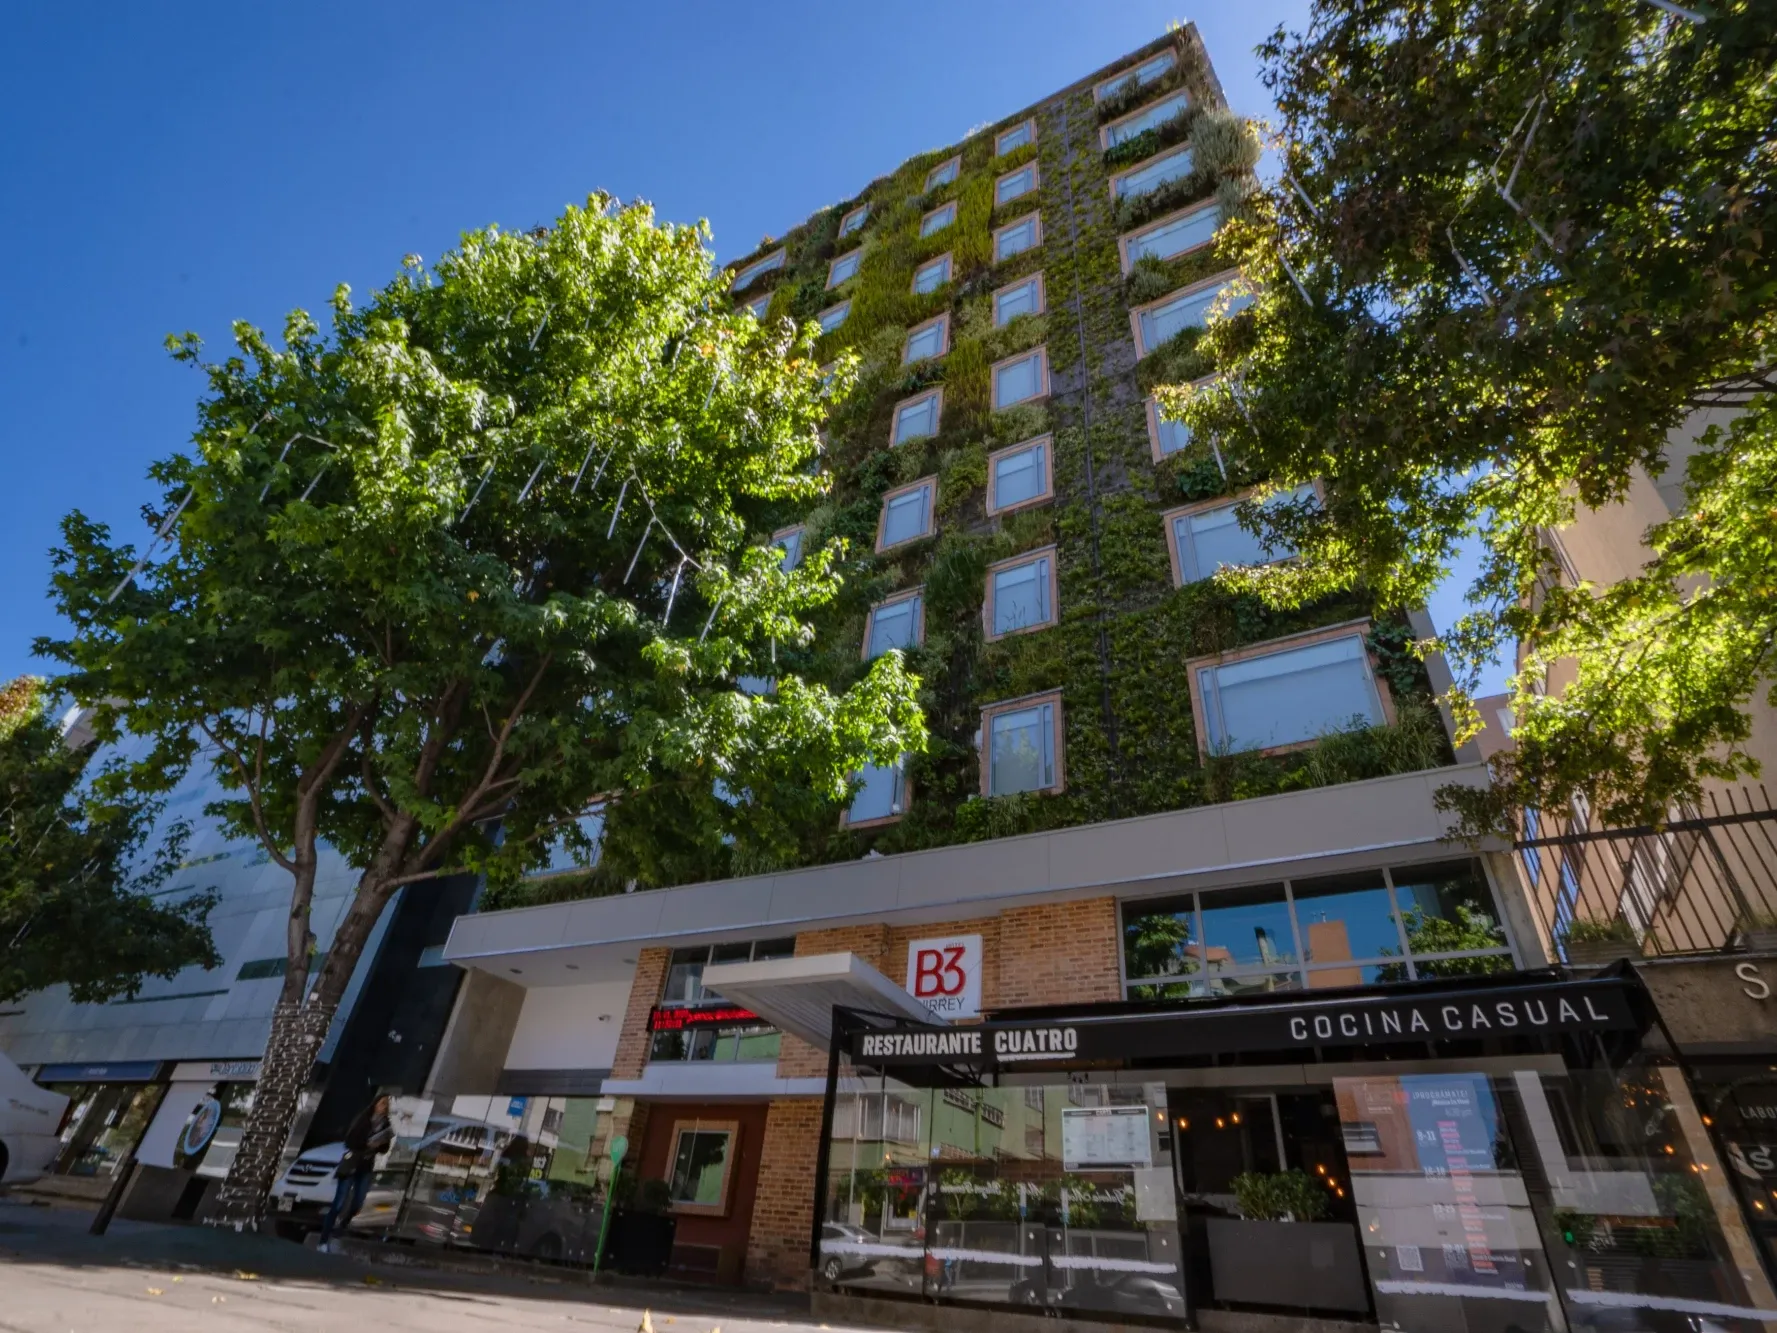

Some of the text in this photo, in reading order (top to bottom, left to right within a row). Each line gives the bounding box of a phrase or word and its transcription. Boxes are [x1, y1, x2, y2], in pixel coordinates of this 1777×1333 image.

[914, 948, 967, 998] B3
[1735, 963, 1771, 1000] S
[1290, 996, 1610, 1041] COCINA CASUAL
[862, 1027, 1078, 1057] RESTAURANTE CUATRO
